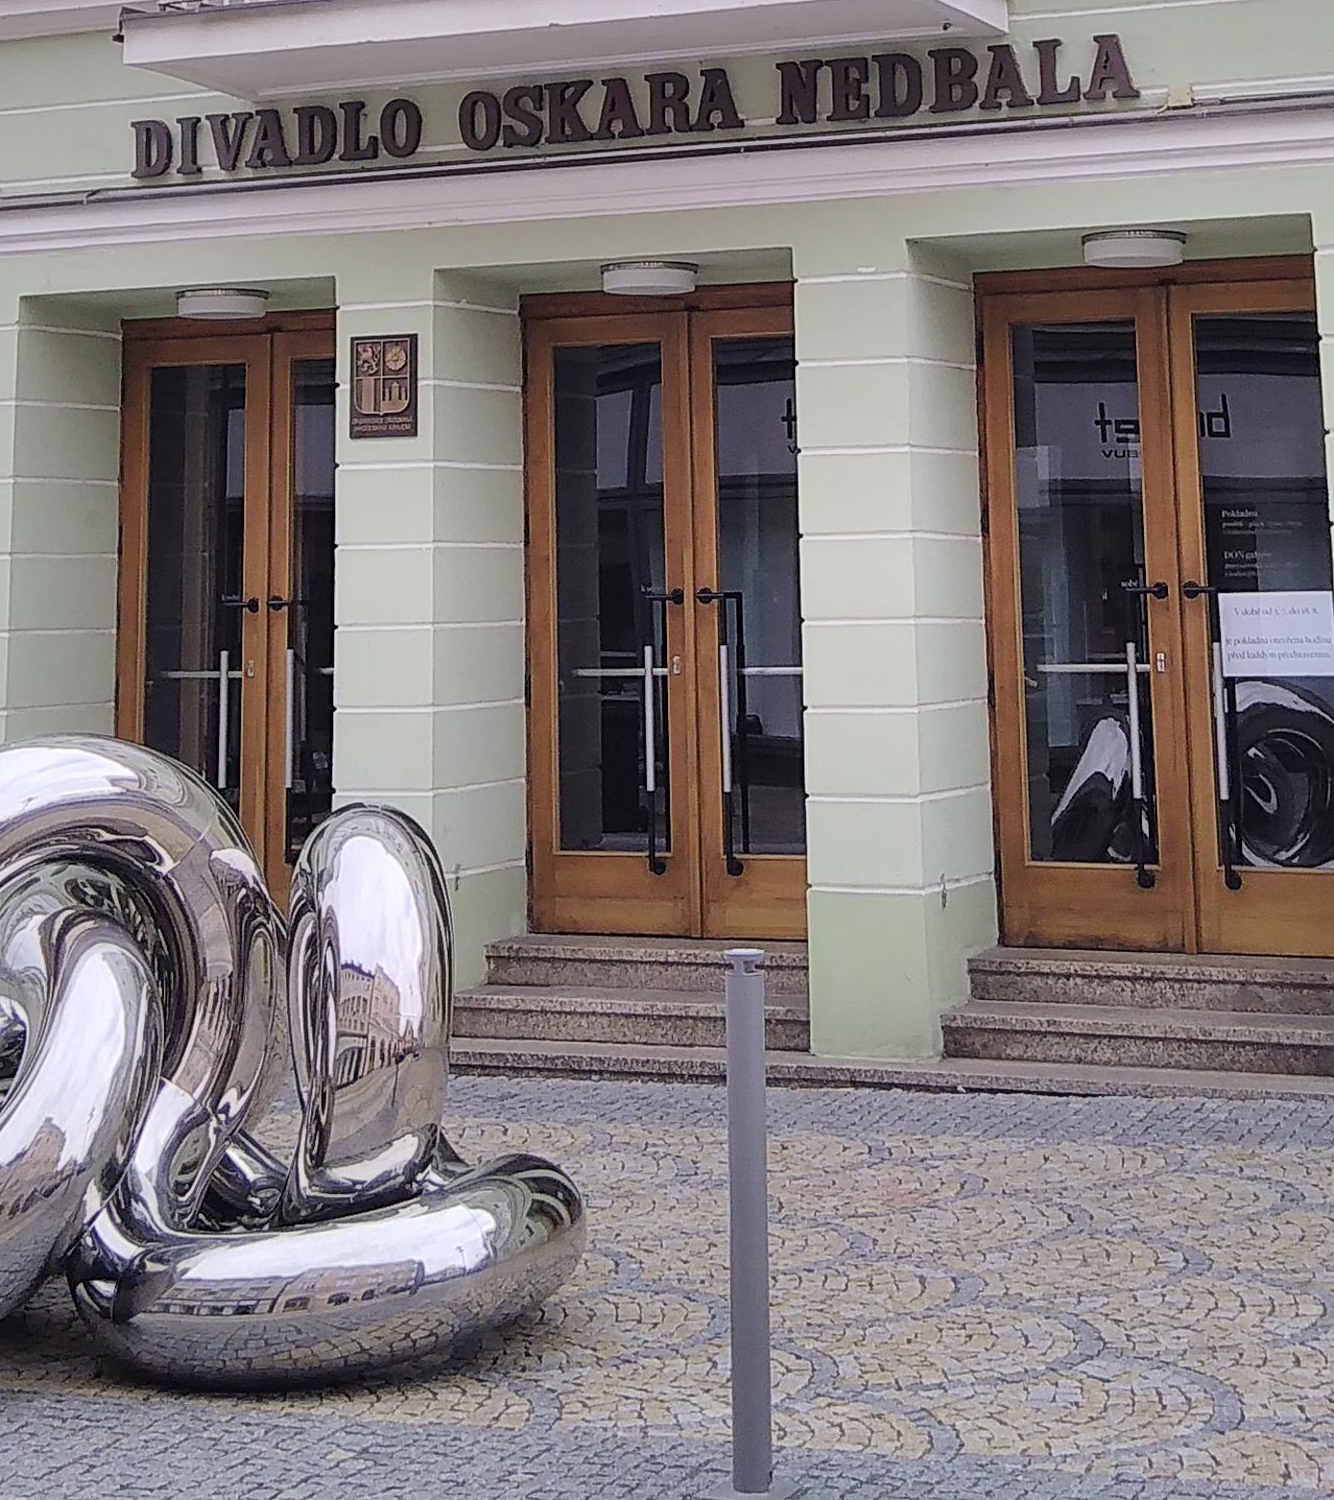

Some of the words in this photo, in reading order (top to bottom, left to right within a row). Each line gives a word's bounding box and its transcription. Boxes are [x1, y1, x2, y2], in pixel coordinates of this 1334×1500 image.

[131, 97, 423, 179] DIVADLO
[459, 68, 744, 151] OSKARA
[775, 33, 1140, 125] NEDBALA
